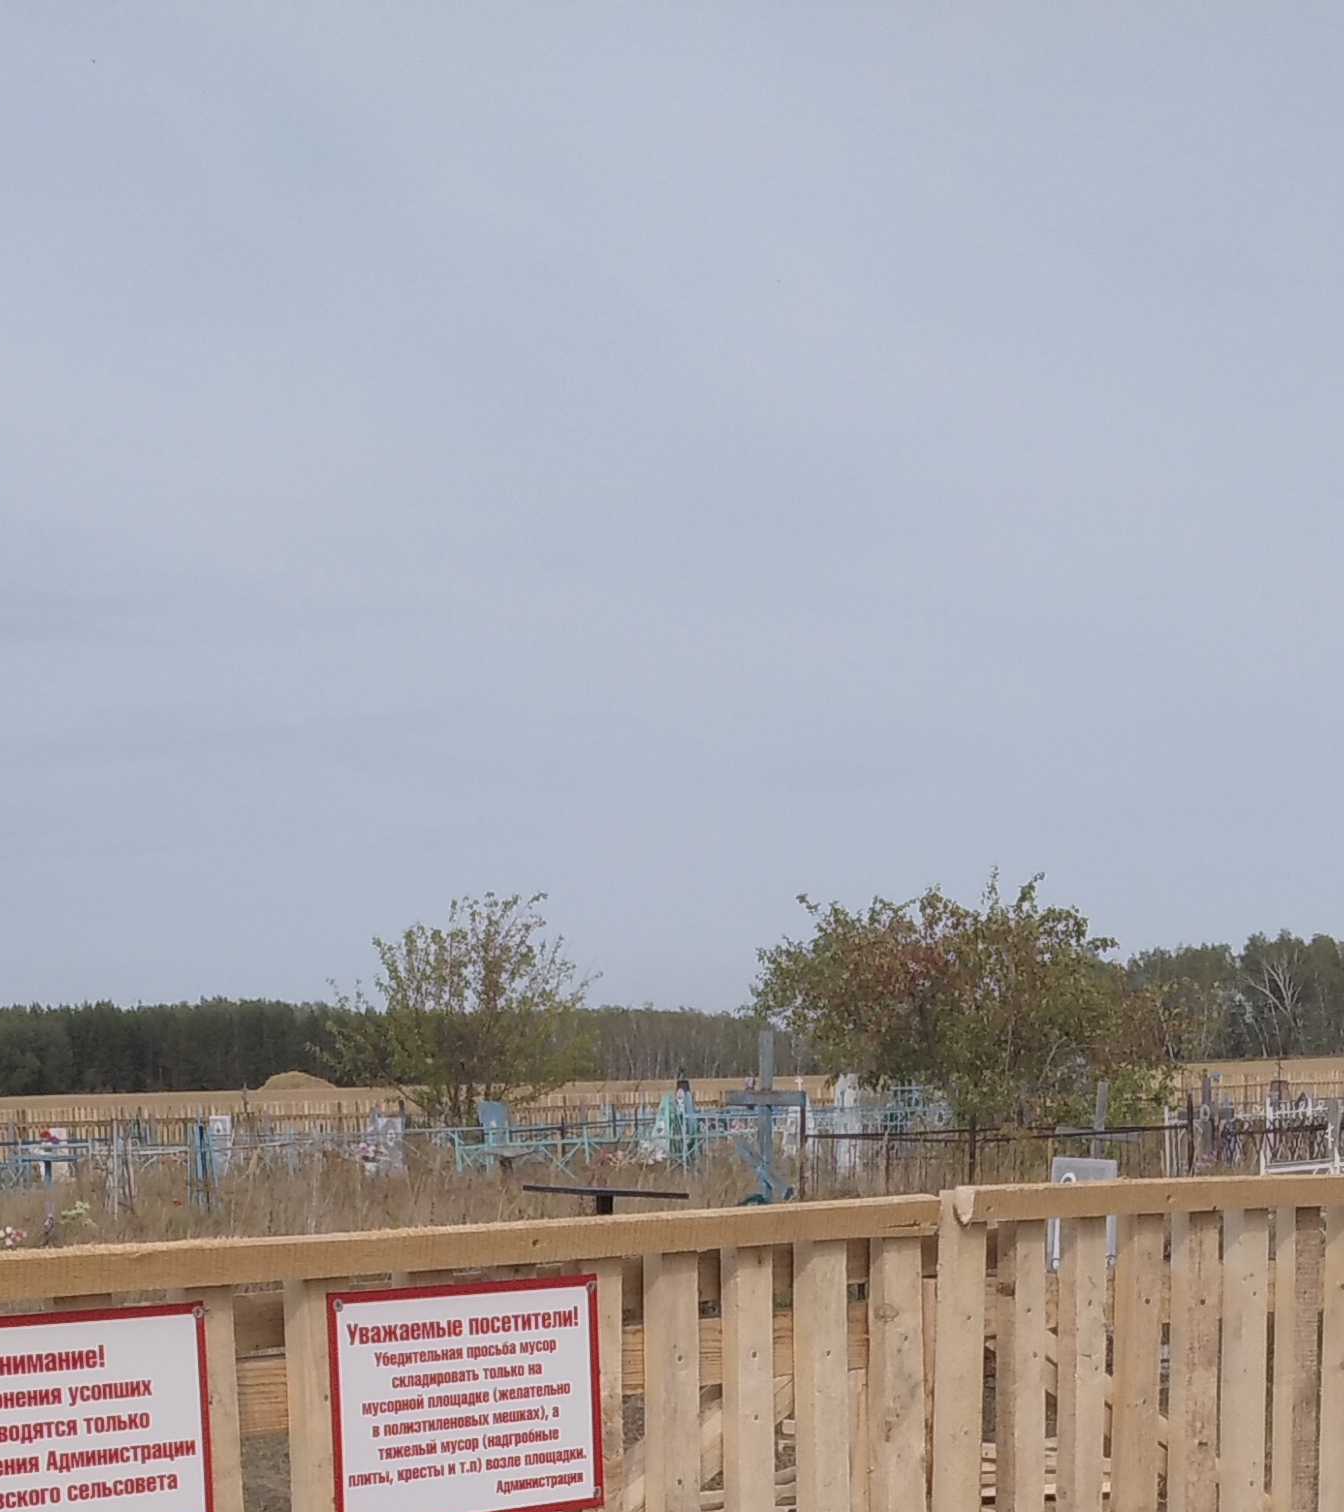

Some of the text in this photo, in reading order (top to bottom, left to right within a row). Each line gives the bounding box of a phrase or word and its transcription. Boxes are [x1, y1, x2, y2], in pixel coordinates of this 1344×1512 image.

[347, 1307, 578, 1345] Уважаемые посетители!
[374, 1339, 556, 1367] Убедительная просьба мусор
[392, 1364, 542, 1388] складировать только на
[69, 1380, 152, 1406] усопших
[363, 1383, 570, 1415] мусорной площадке (желательно
[84, 1412, 150, 1433] только
[373, 1405, 559, 1437] в полиэтиленовых мешках), а
[46, 1440, 196, 1472] Администрации
[378, 1428, 559, 1459] тяжелый мусор (надгробные
[349, 1448, 587, 1487] плиты, кресты и т.п) возле площадки.
[68, 1473, 178, 1501] сельсовета
[496, 1472, 583, 1493] Администрация
